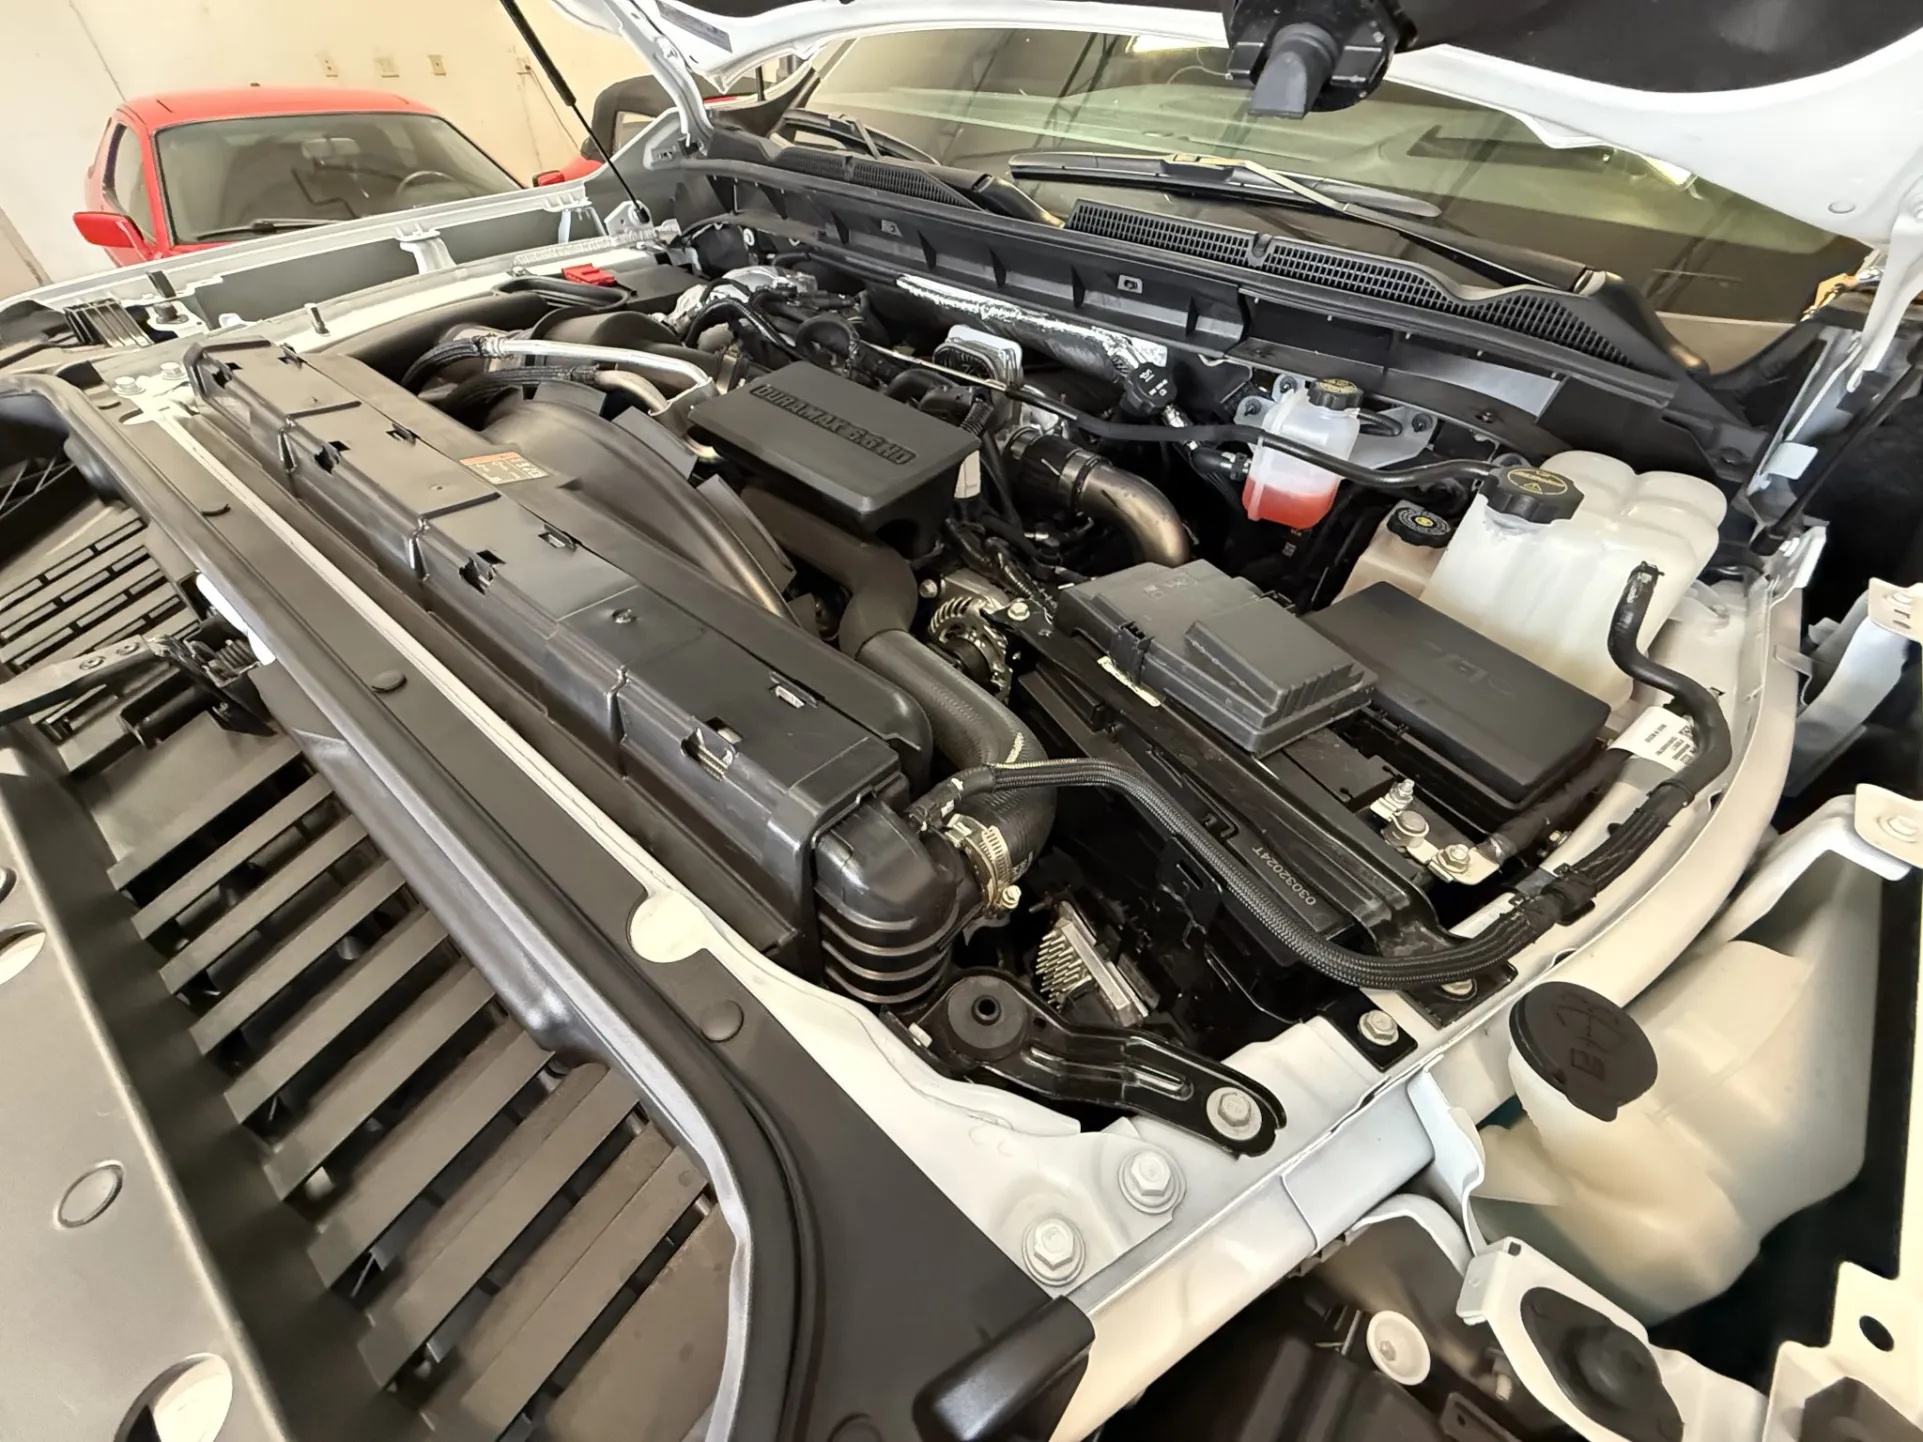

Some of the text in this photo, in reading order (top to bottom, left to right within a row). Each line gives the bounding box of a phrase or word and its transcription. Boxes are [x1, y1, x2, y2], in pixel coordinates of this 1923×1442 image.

[753, 385, 850, 433] DURAMAX
[881, 444, 915, 464] HD
[1251, 847, 1317, 906] 03032024T
